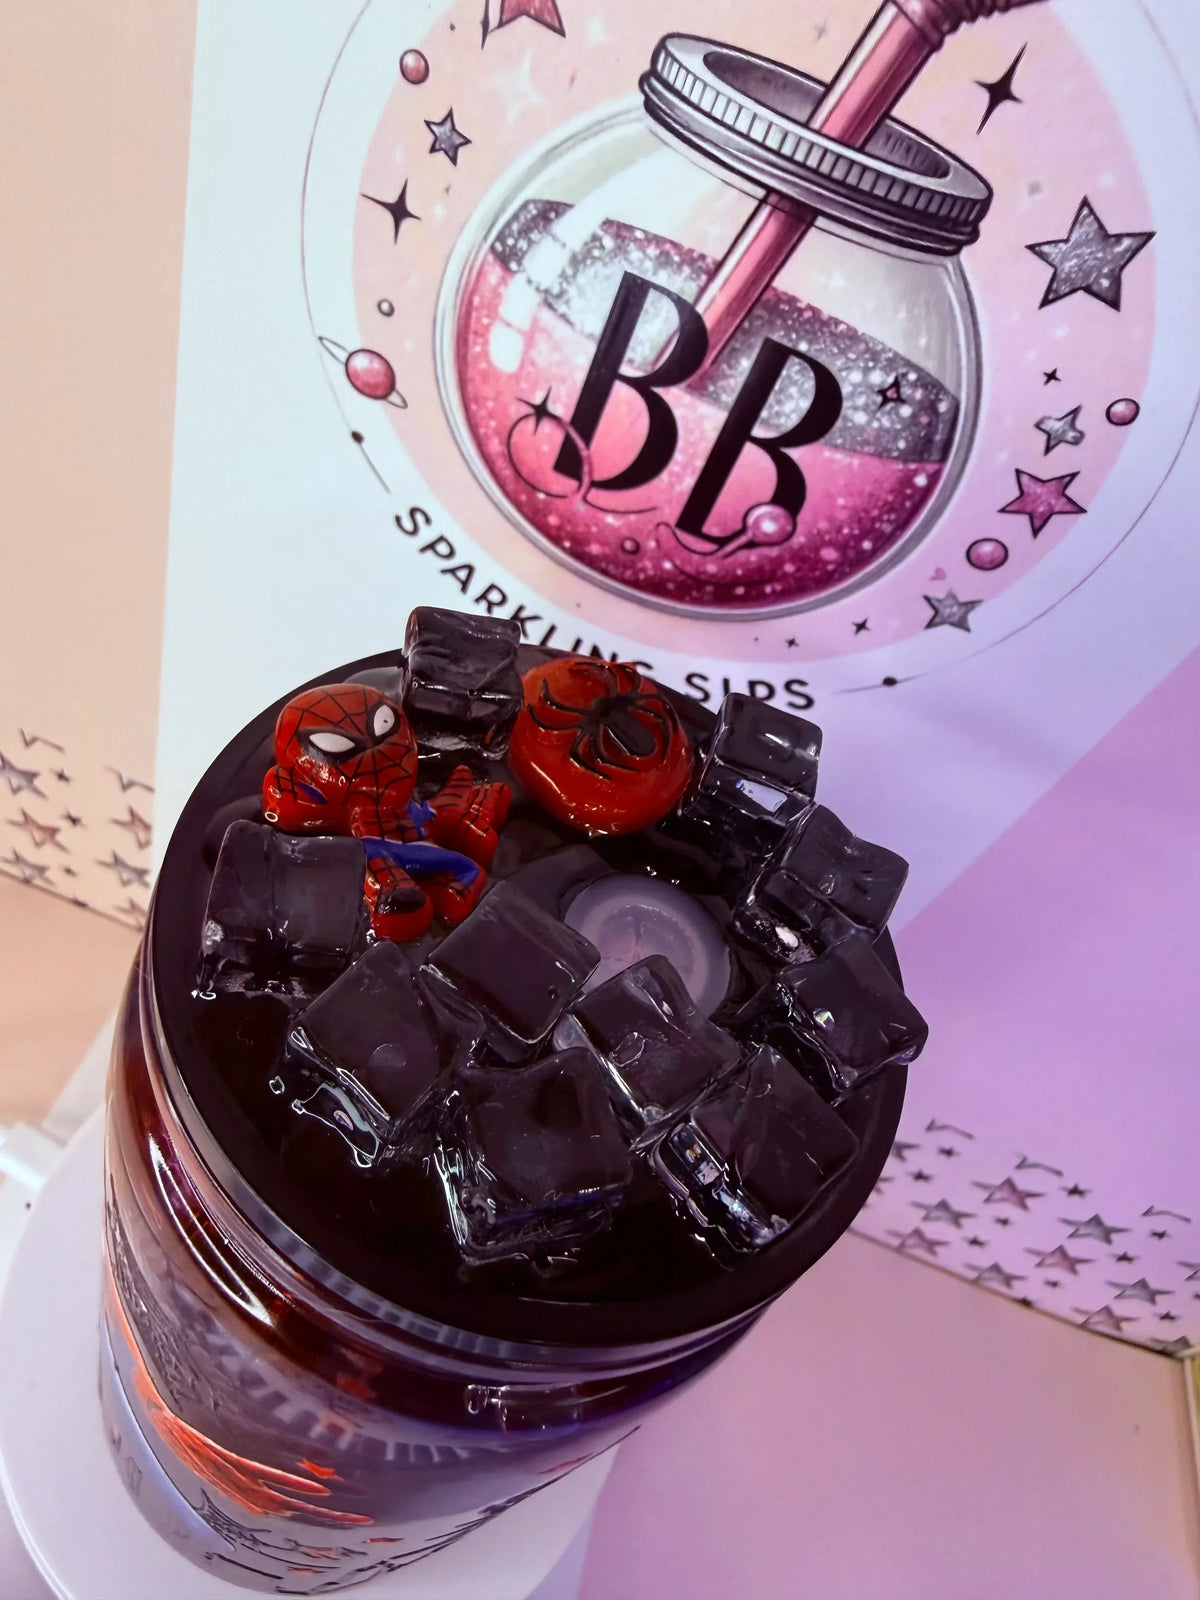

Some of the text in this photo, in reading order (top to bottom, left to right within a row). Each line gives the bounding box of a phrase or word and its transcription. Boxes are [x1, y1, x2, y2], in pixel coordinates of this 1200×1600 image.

[552, 270, 843, 547] BB
[395, 506, 815, 710] SPARKL SIPS
